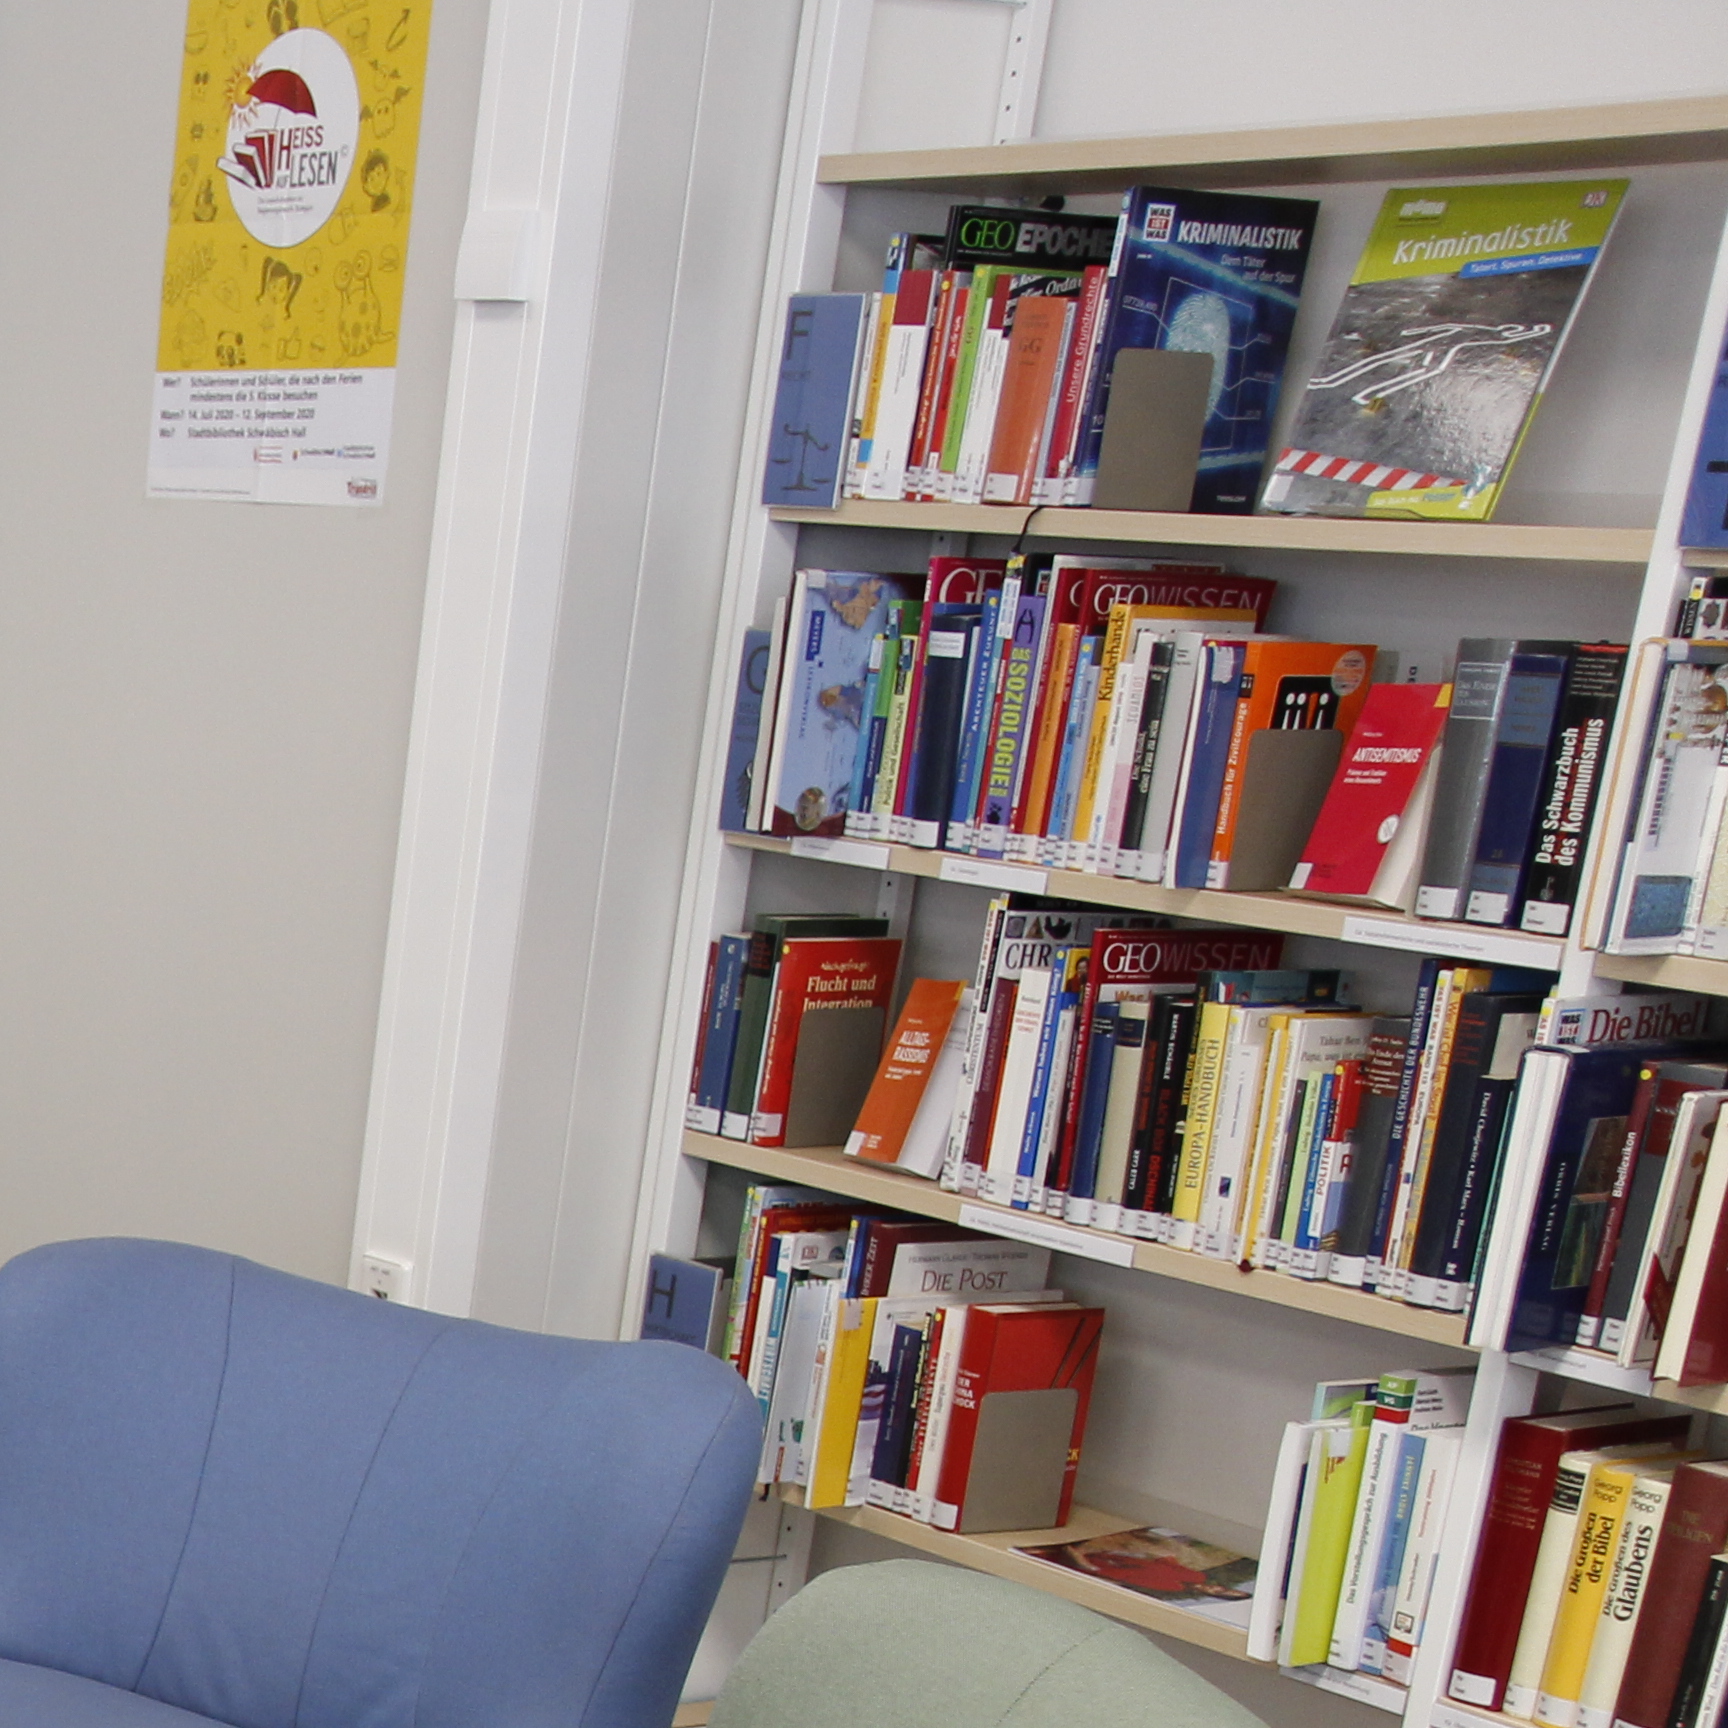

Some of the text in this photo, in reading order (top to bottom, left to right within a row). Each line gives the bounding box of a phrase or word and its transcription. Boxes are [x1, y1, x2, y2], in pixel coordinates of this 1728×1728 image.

[278, 125, 325, 171] HEISS
[290, 151, 338, 188] LESEN
[1149, 205, 1173, 217] WAS
[959, 216, 1016, 260] GEO
[1145, 229, 1168, 241] WAS
[1177, 219, 1303, 251] KRIMINALISTIK
[1391, 217, 1571, 266] Kriminalistik
[1065, 276, 1099, 404] Unsere Grundrechte
[1216, 702, 1247, 834] Handbuch für Zivilcourage
[1351, 746, 1424, 765] ANTISEMITISMUS
[1535, 726, 1578, 863] Das Schwarzbuch
[1554, 717, 1604, 866] des Kommunismus
[807, 974, 877, 993] Flucht und
[1102, 944, 1160, 976] GEO
[1391, 986, 1429, 1141] DIE GESCHICHTE DER BUNDESWEHR
[1184, 1038, 1222, 1191] EUROPA-HANDBUCH
[1315, 1145, 1332, 1197] POLITIK
[1610, 1131, 1637, 1199] Bibellexikon
[921, 1267, 1009, 1293] DIE POST
[1594, 1480, 1624, 1496] Georg
[1595, 1490, 1618, 1505] Popp
[1633, 1487, 1663, 1504] Georg
[1633, 1497, 1657, 1515] Popp
[1346, 1432, 1388, 1605] Das Vorstellungsgespräch zur Ausbildung
[1567, 1511, 1597, 1595] Die Großen
[1588, 1515, 1616, 1584] der Bibel
[1600, 1519, 1635, 1617] Die Großen des
[1612, 1523, 1654, 1623] Glaubens
